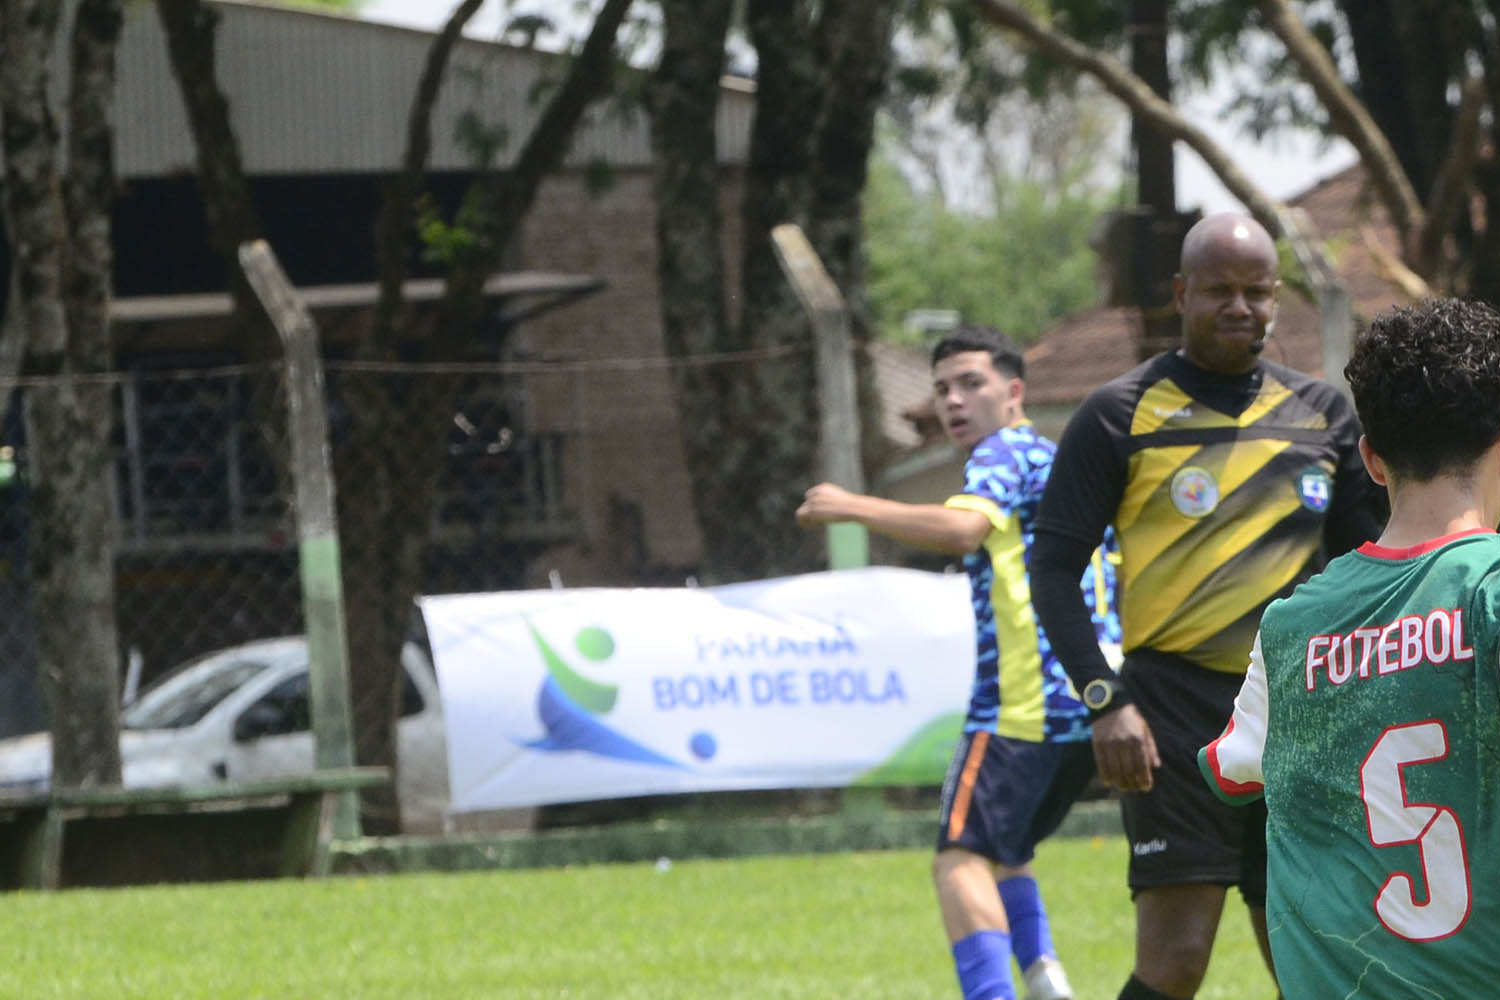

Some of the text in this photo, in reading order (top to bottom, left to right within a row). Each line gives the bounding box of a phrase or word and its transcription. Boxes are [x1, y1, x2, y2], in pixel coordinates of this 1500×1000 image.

[652, 667, 909, 711] BOM DE BOLA
[1304, 607, 1475, 692] FUTEBOL
[1358, 719, 1472, 942] 5
